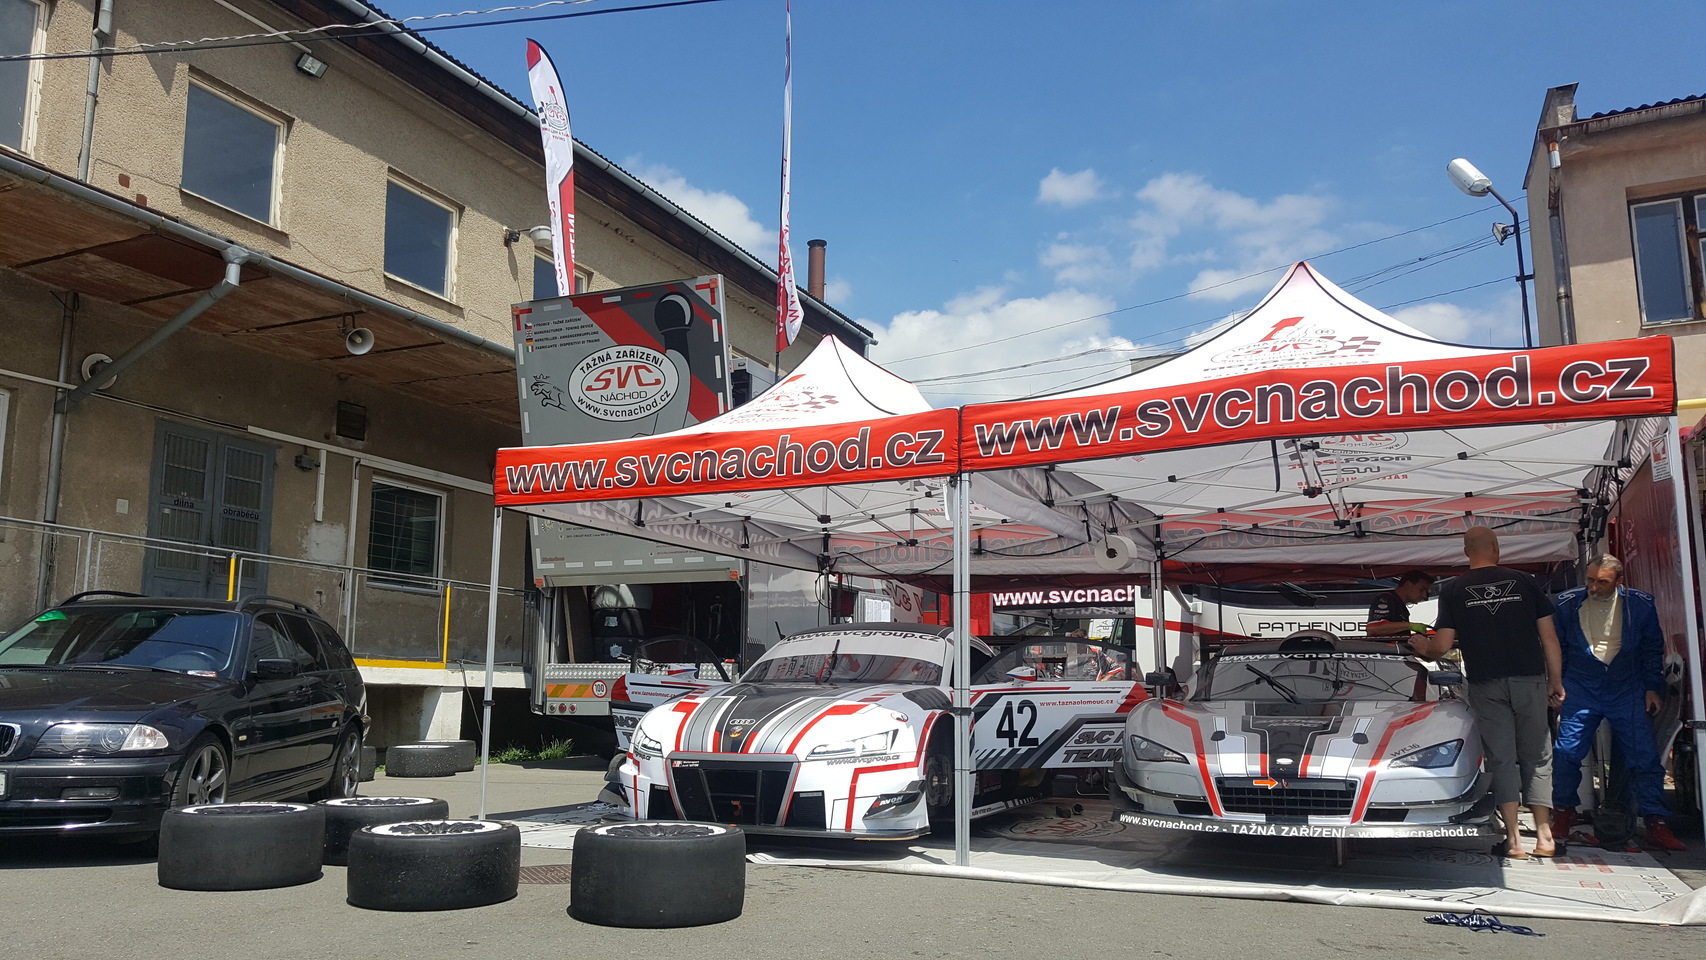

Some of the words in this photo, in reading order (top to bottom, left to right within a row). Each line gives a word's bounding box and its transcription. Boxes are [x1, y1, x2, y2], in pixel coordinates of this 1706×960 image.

[579, 352, 613, 374] TAŽNÁ
[615, 348, 665, 367] ZAŘÍZENÍ
[584, 364, 662, 392] SVC
[577, 389, 672, 418] www.svcnachod.cz
[600, 390, 648, 403] NÁCHOD
[973, 355, 1656, 460] www.svcnachod.cz
[505, 426, 946, 495] www.svcnachod.cz
[785, 630, 941, 643] www.svcgroup.cz
[1219, 652, 1407, 663] www.svcnachod.cz
[594, 684, 605, 693] 100
[1039, 698, 1114, 707] www.taznaolomouc.cz
[995, 699, 1039, 748] 42
[1073, 730, 1115, 745] SVC
[1061, 748, 1123, 764] TEAM
[1119, 813, 1220, 833] www.svcnachod.cz
[1231, 824, 1277, 836] TAŽNÁ
[1280, 825, 1347, 838] ZAŘÍZENÍ
